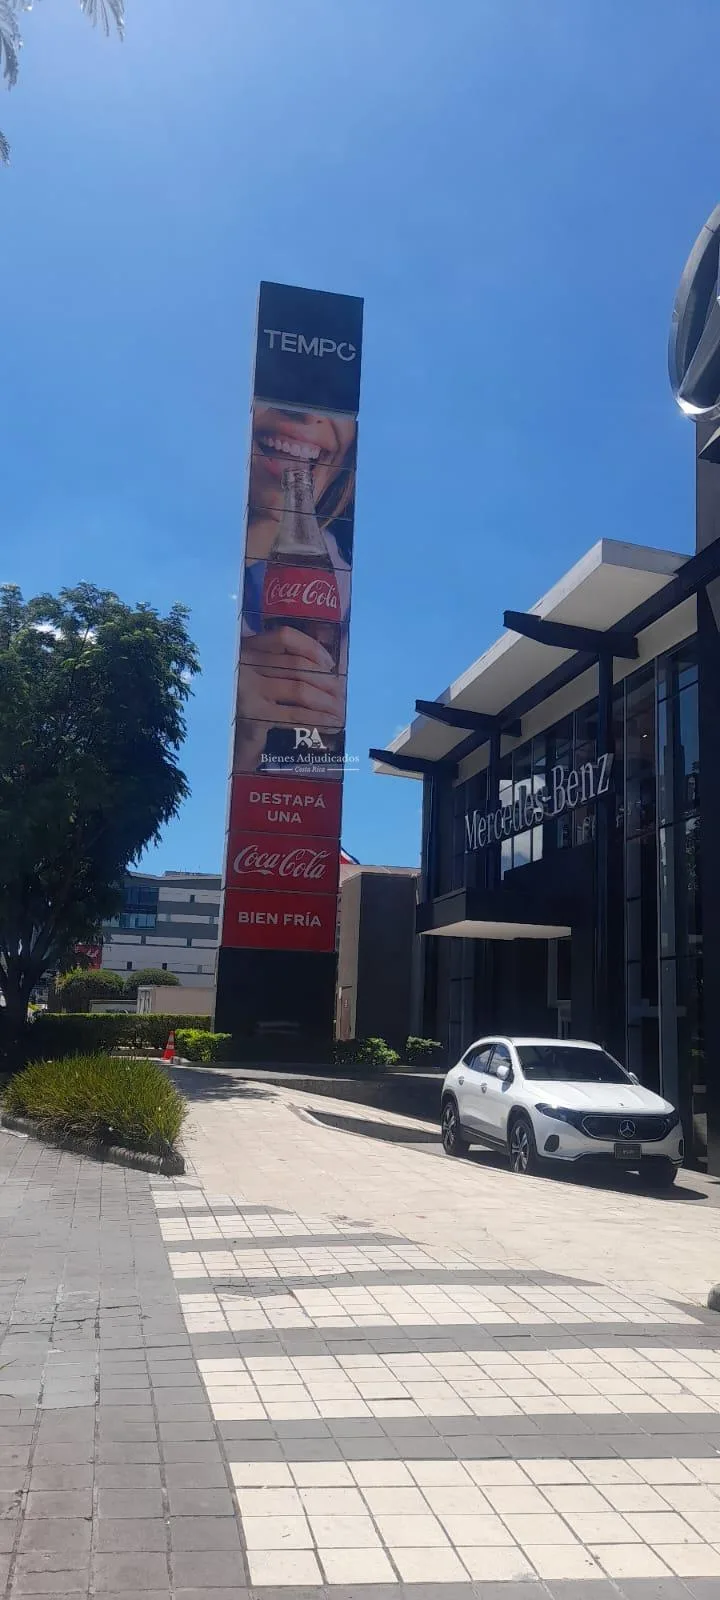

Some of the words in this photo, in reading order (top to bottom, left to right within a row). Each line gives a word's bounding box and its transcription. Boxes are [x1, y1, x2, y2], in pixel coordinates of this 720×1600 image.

[263, 328, 357, 362] TEMPO
[265, 578, 338, 609] Coca-Cola
[249, 791, 326, 809] DESTAPÁ
[464, 752, 616, 851] Mercedes-Benz
[267, 810, 302, 824] UNA
[233, 844, 331, 880] Coca-Cola
[238, 911, 278, 925] BIEN
[283, 911, 322, 928] FRÍA
